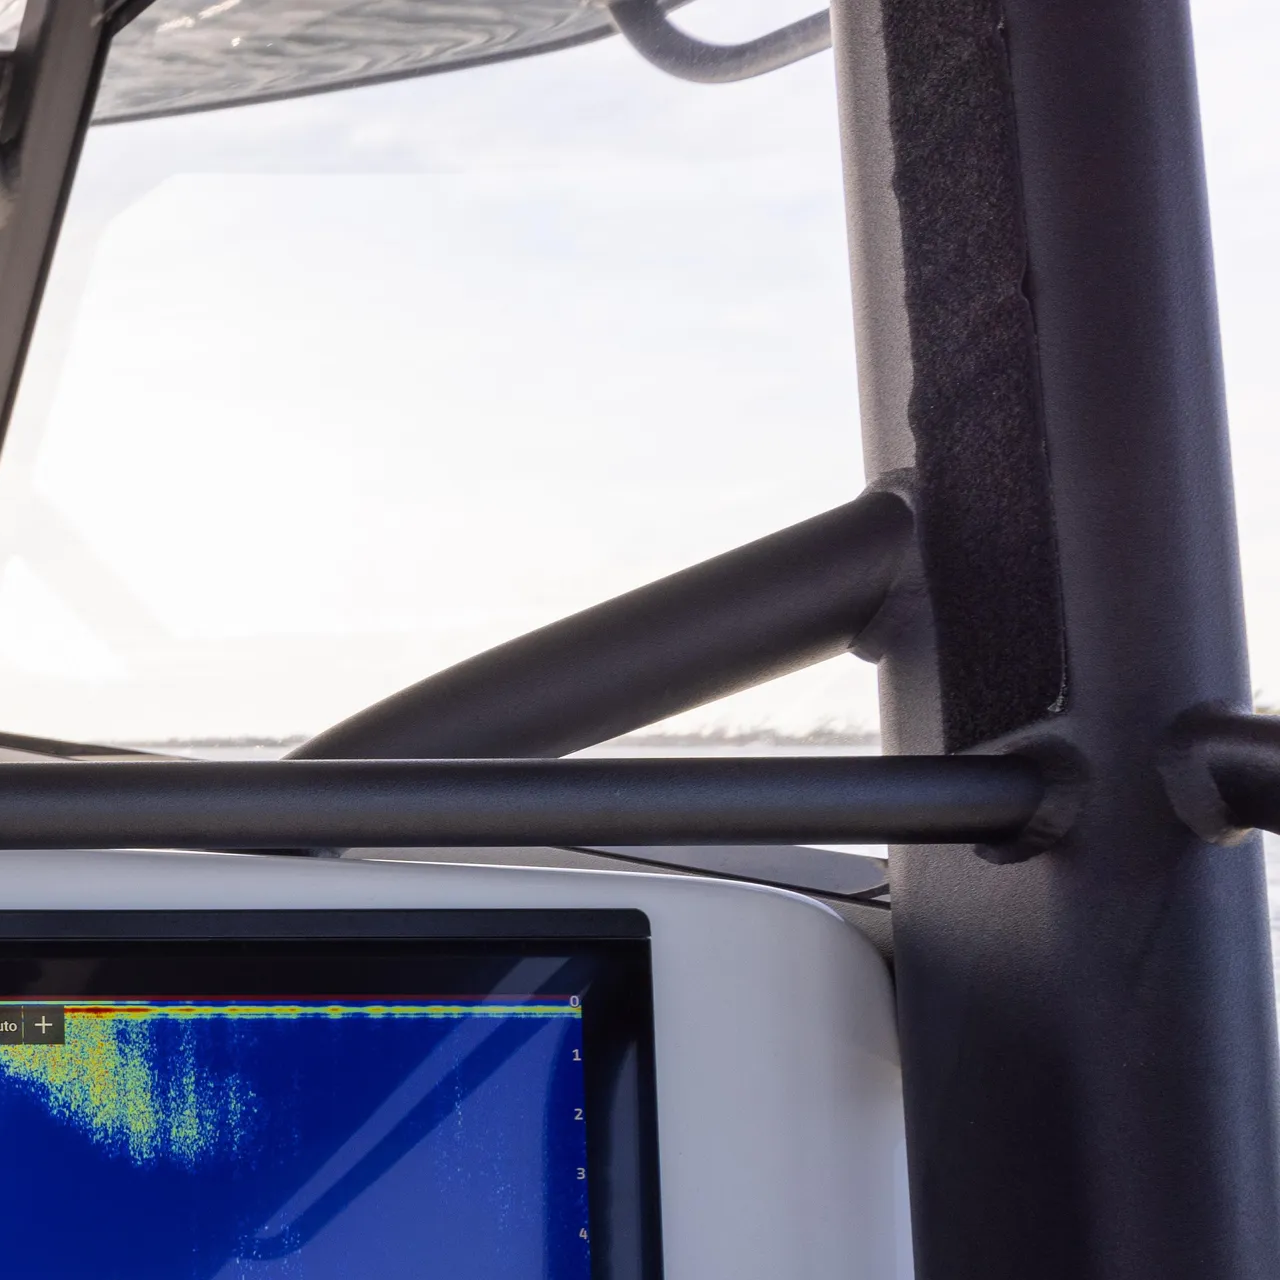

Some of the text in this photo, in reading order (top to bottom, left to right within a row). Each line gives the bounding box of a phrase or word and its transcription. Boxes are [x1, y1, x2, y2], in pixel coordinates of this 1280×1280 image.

[569, 996, 579, 1007] 0
[572, 1049, 582, 1061] 1
[574, 1108, 584, 1120] 2
[576, 1168, 586, 1180] 3
[578, 1228, 588, 1240] 4
